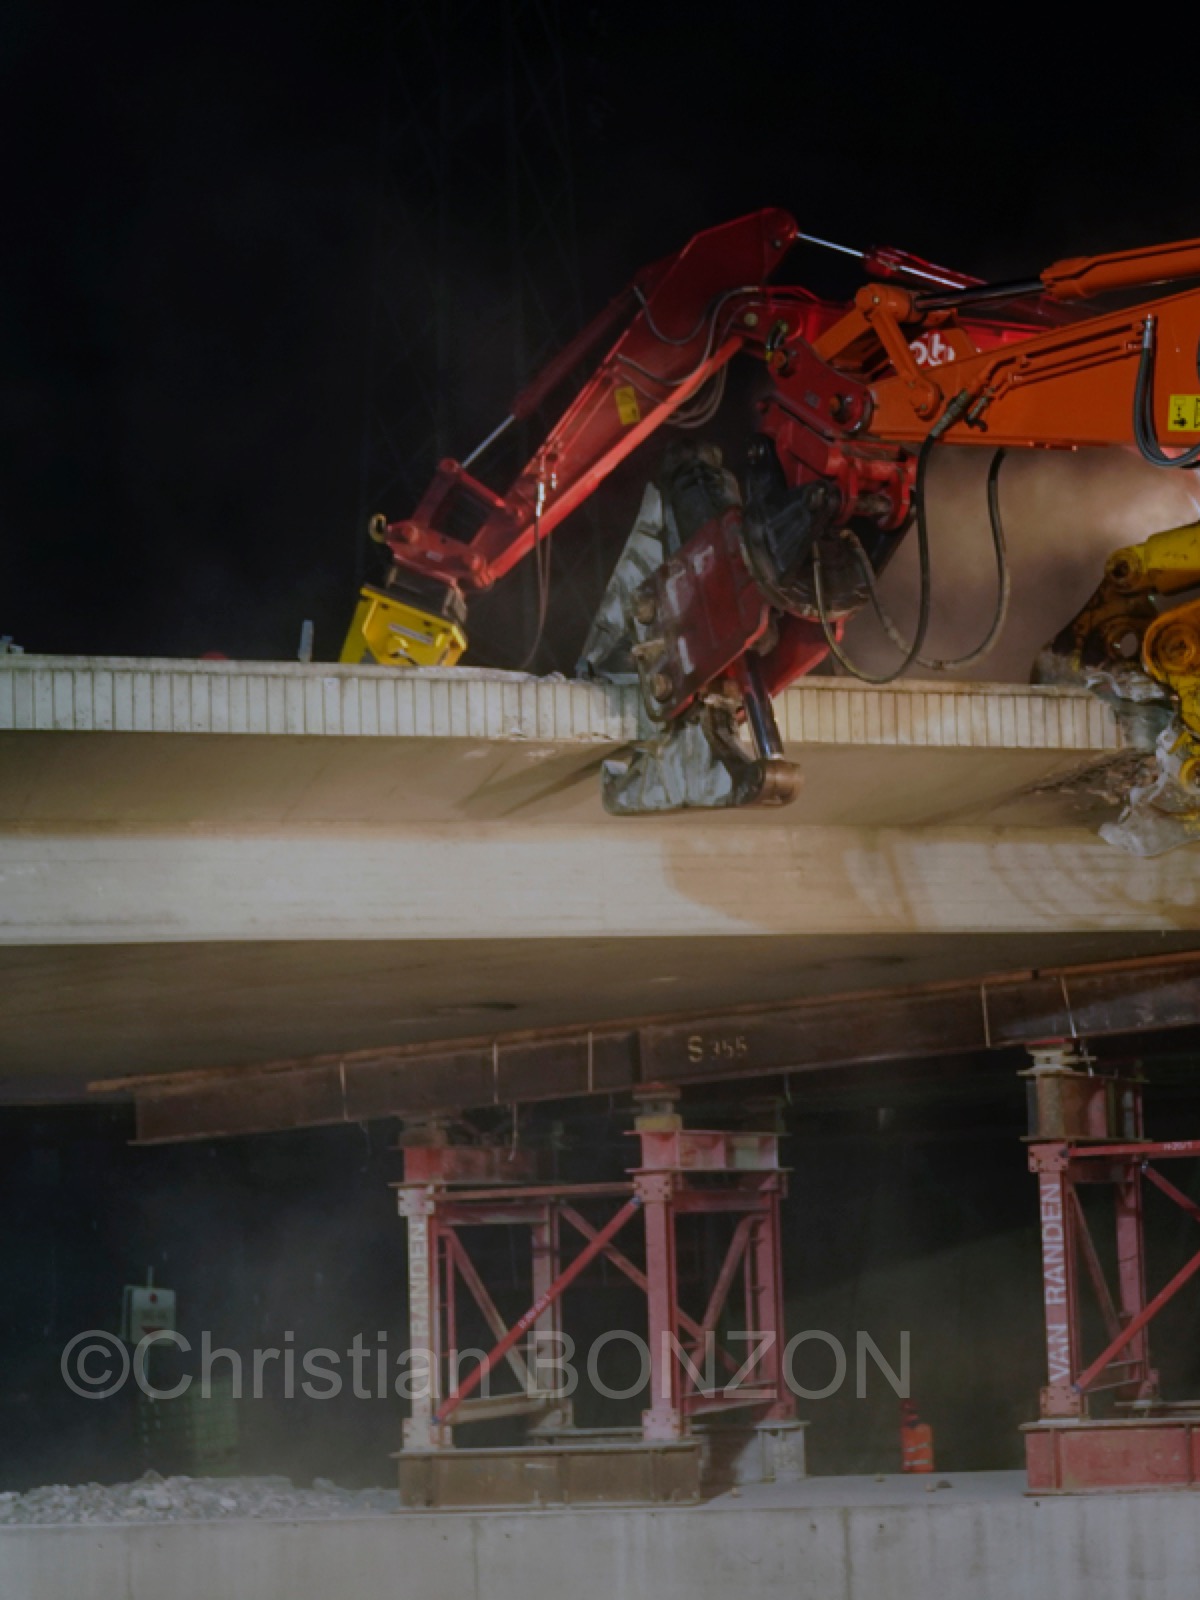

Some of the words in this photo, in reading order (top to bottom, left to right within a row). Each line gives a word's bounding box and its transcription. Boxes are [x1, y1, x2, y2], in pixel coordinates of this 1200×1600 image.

[687, 1035, 703, 1062] S
[1041, 1183, 1067, 1305] RANDEN
[1048, 1323, 1070, 1382] VAN
